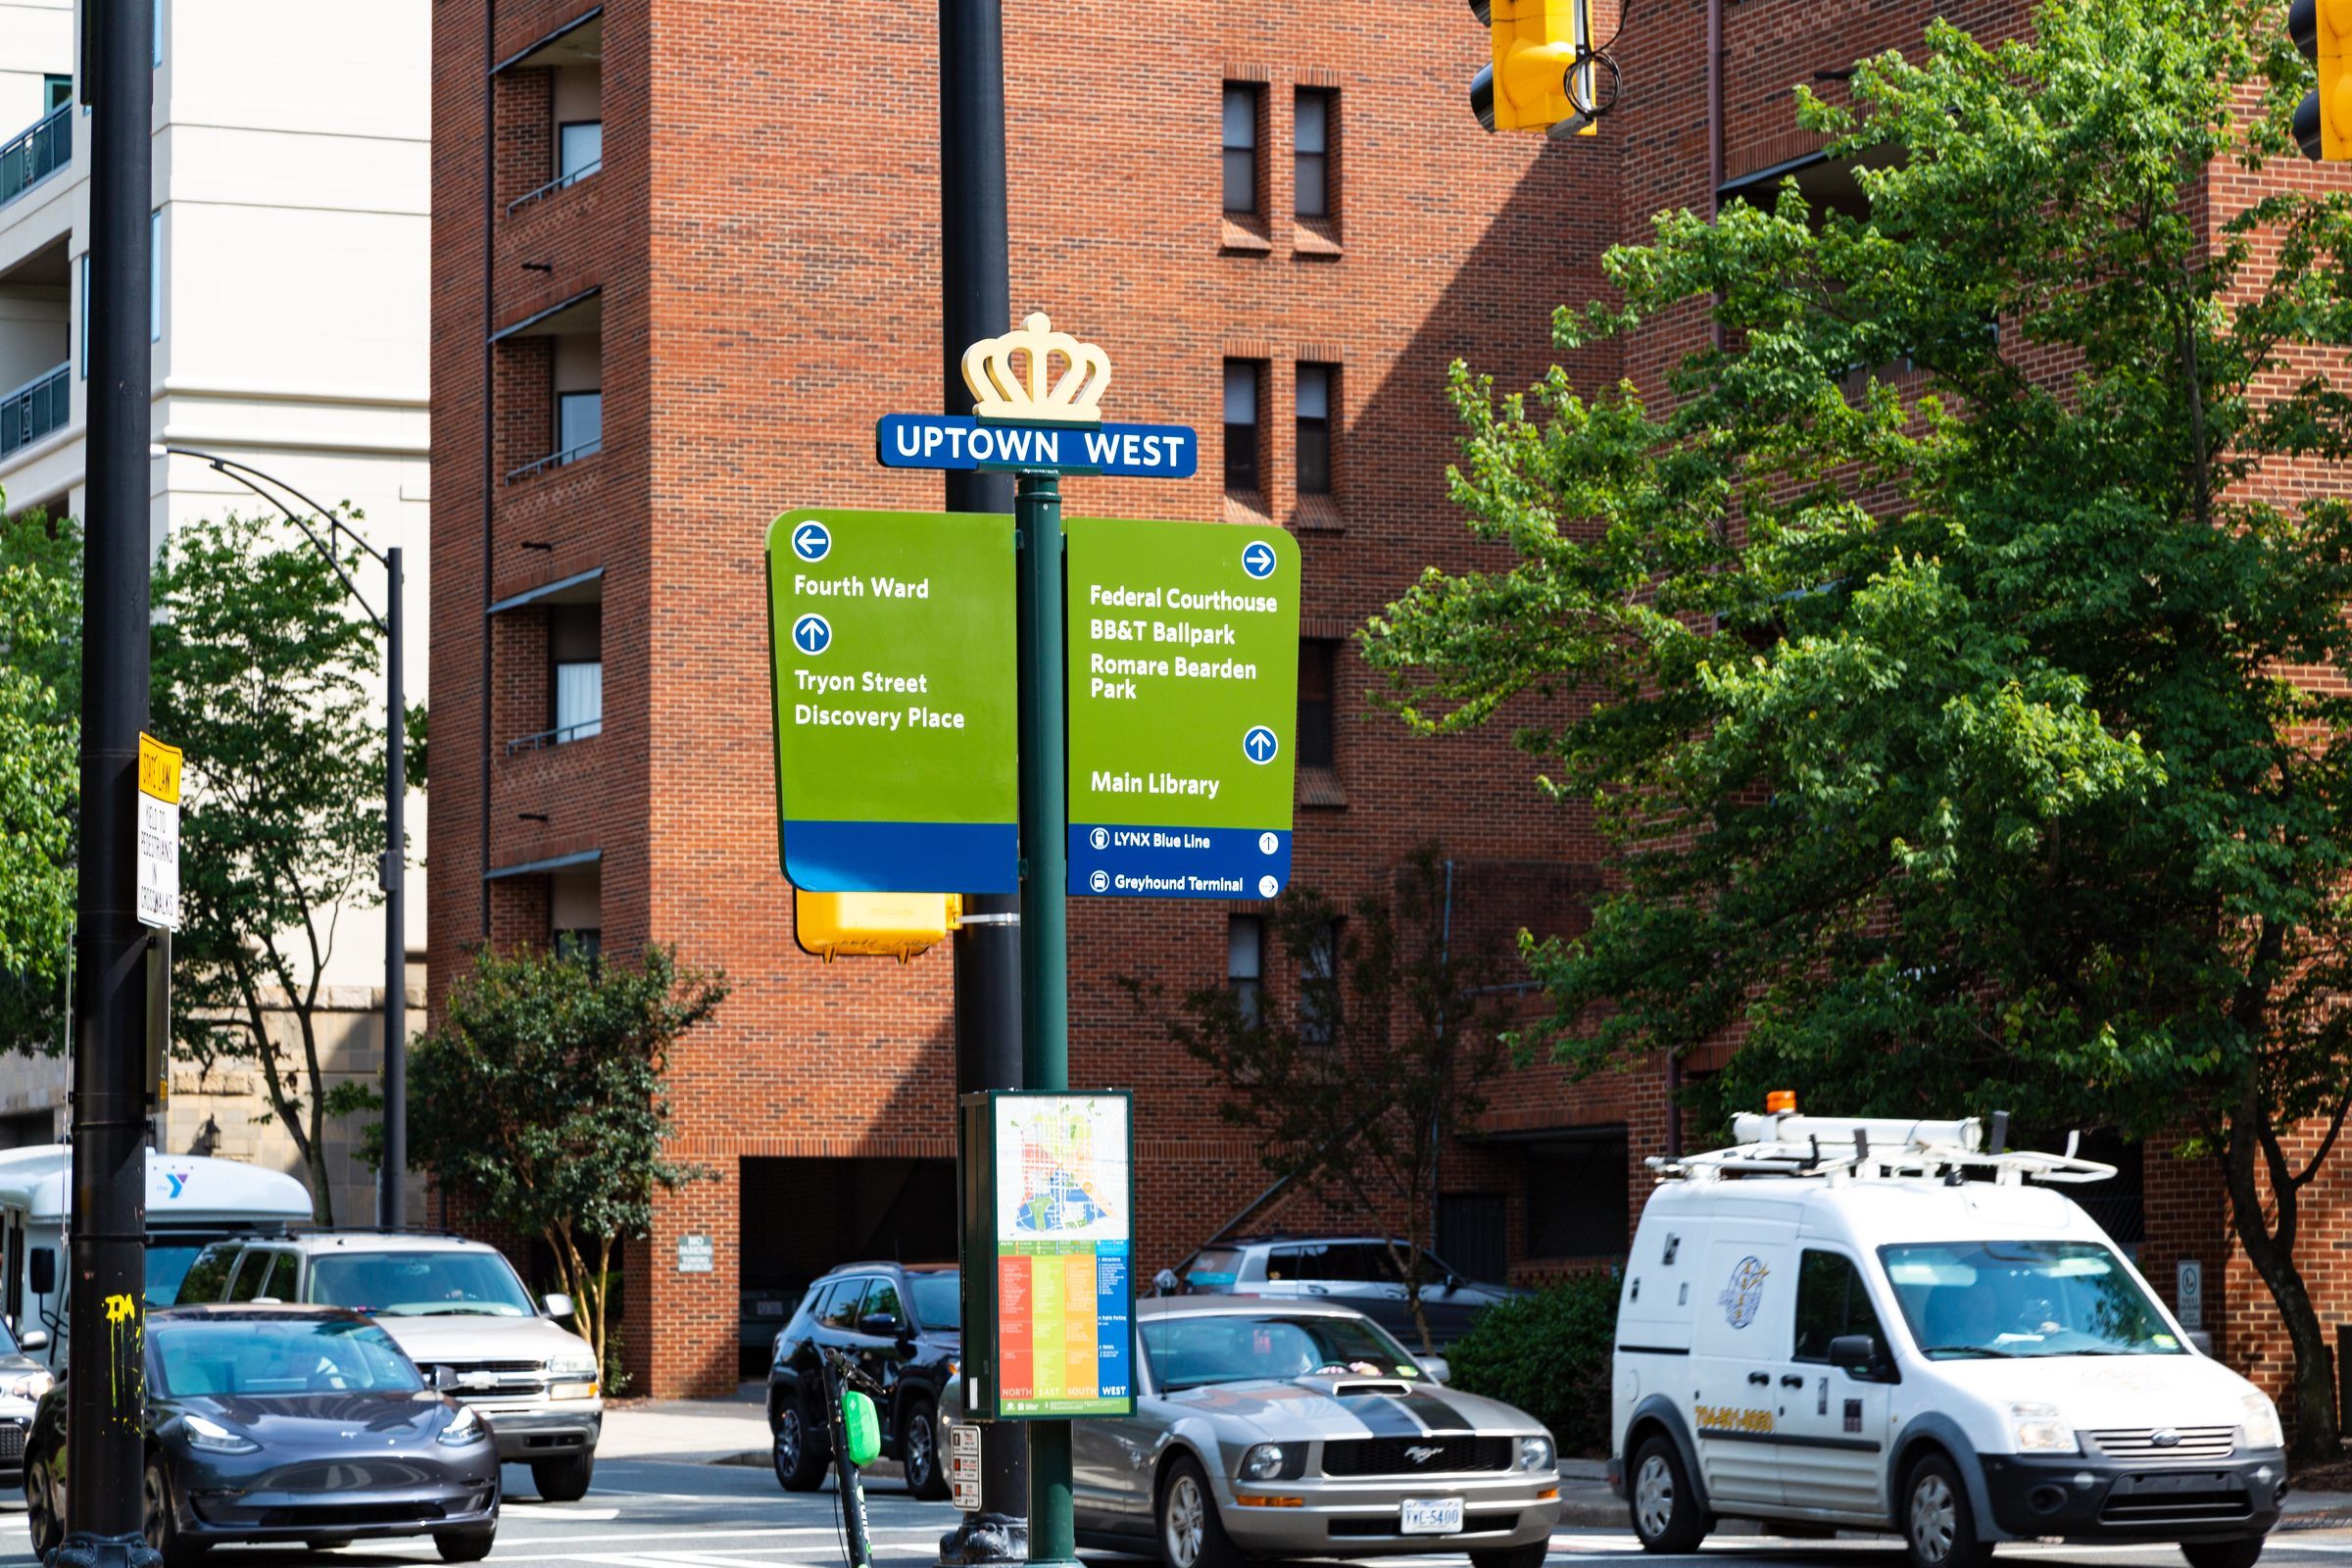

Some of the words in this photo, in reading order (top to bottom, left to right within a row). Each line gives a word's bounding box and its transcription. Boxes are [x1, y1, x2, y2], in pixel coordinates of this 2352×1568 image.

[898, 425, 1058, 463] UPTOWN
[1085, 433, 1184, 467] WEST
[795, 574, 863, 597] Fourth
[871, 577, 929, 599] Ward
[1090, 585, 1161, 609] Federal
[1166, 588, 1278, 613] Courthouse
[1091, 619, 1148, 642] BB&T
[1152, 621, 1236, 647] Ballpark
[1091, 654, 1169, 677] Romare
[1174, 657, 1257, 680] Bearden
[795, 670, 856, 695] Tryon
[862, 671, 927, 694] Street
[1091, 677, 1137, 700] Park
[795, 705, 902, 731] Discovery
[907, 707, 965, 728] Place
[158, 763, 172, 795] LAW
[1091, 771, 1143, 793] Main
[1149, 773, 1220, 800] Library
[141, 830, 173, 863] PEDESTRIANS
[1114, 832, 1151, 847] LYNX
[1153, 833, 1181, 848] Blue
[1184, 834, 1210, 849] Line
[1114, 873, 1186, 892] Greyhound
[1188, 876, 1244, 892] Terminal
[141, 885, 173, 917] CROSSWALKS
[687, 1236, 705, 1246] NO
[1002, 1387, 1032, 1396] NORTH
[1039, 1387, 1060, 1396] EAST
[1067, 1387, 1097, 1396] SOUTH
[1102, 1386, 1127, 1396] WEST
